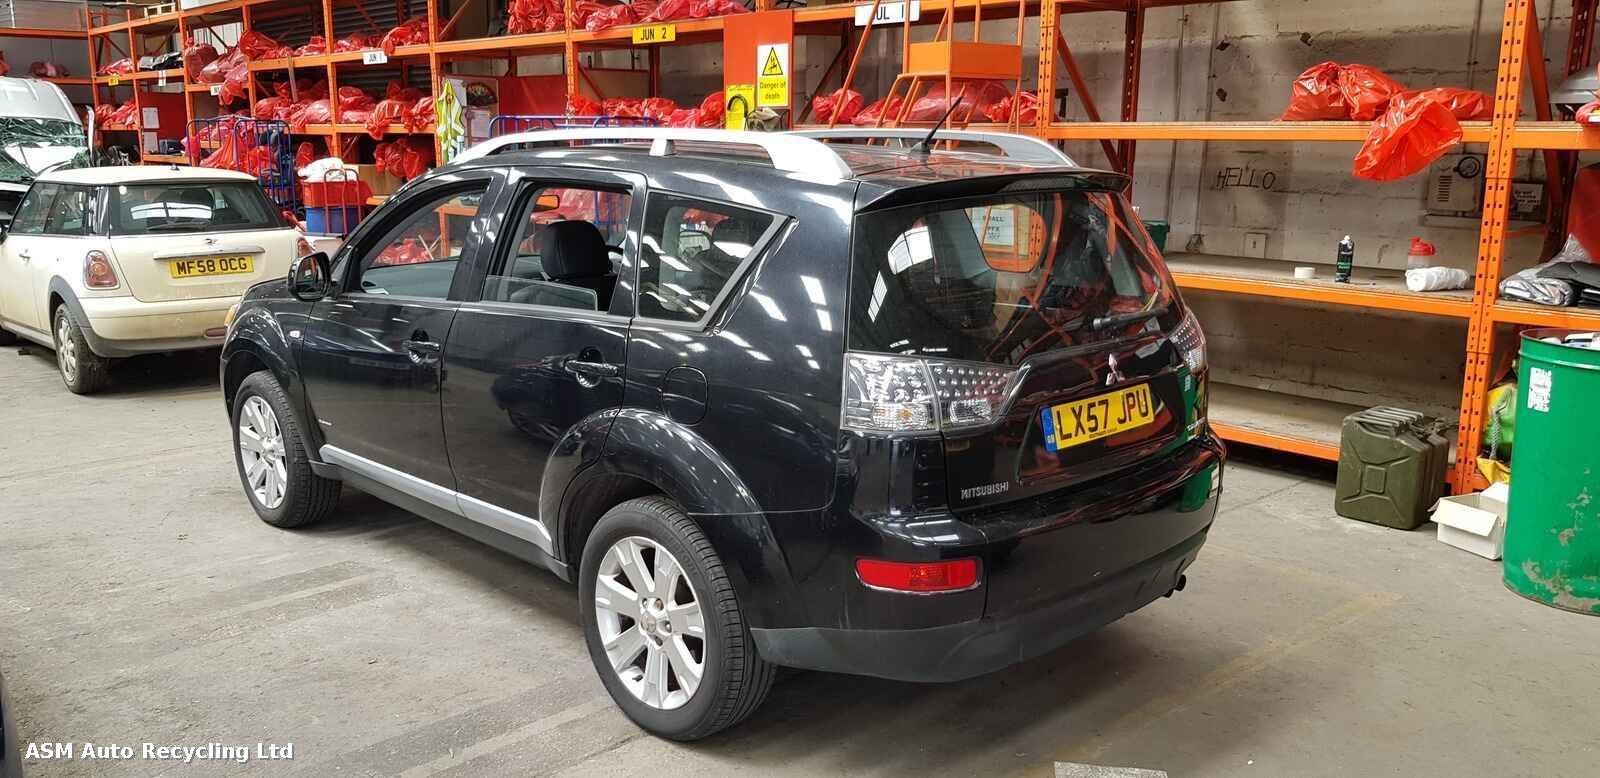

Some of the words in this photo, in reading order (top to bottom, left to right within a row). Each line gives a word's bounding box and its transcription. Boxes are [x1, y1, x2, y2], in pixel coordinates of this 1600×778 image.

[873, 6, 890, 20] UL
[640, 28, 655, 41] JUN
[661, 27, 667, 40] 2
[760, 82, 778, 90] Danger
[779, 81, 786, 89] of
[1216, 167, 1276, 190] HELLO
[176, 259, 216, 275] MF58
[219, 257, 248, 272] OCG
[1056, 398, 1109, 441] LX57
[1117, 388, 1149, 425] JPU
[960, 481, 1009, 500] MITSUBISHI
